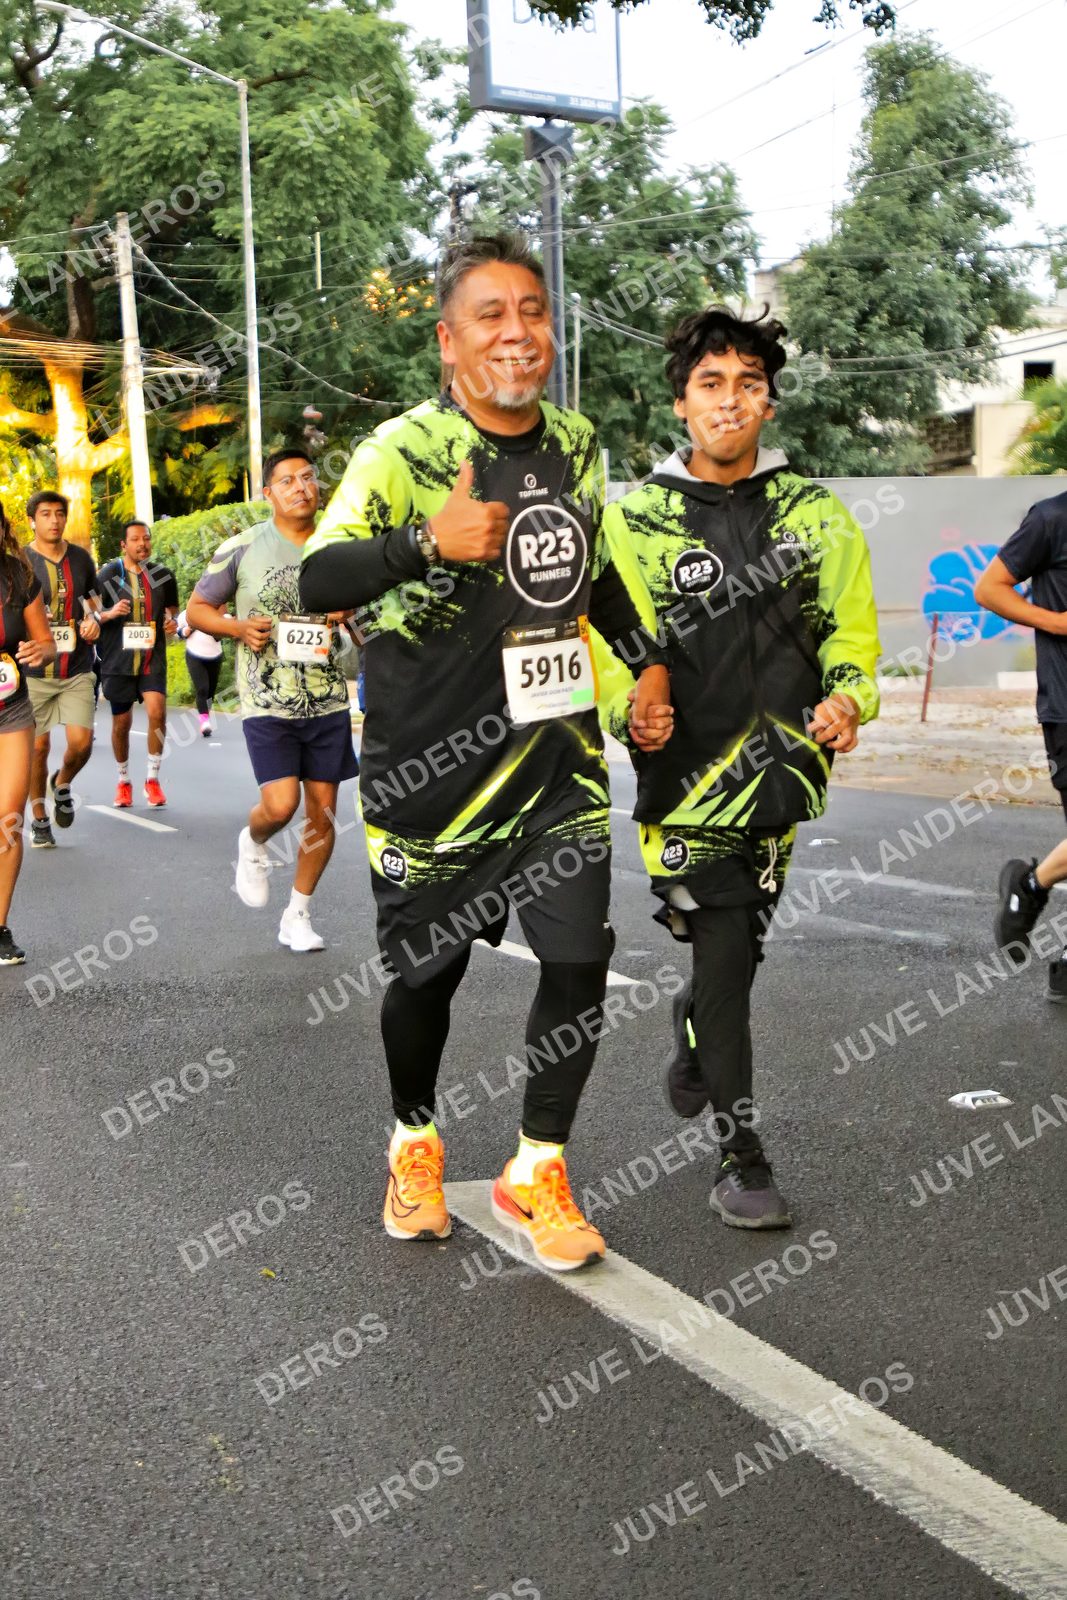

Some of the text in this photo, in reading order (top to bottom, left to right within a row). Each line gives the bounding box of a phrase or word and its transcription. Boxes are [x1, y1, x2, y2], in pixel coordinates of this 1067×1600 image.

[518, 526, 577, 570] R23
[529, 565, 573, 584] RUNNERS
[678, 558, 714, 584] R23
[127, 630, 150, 639] 2003
[286, 629, 324, 646] 6225
[520, 649, 583, 689] 5916
[383, 853, 404, 873] R23
